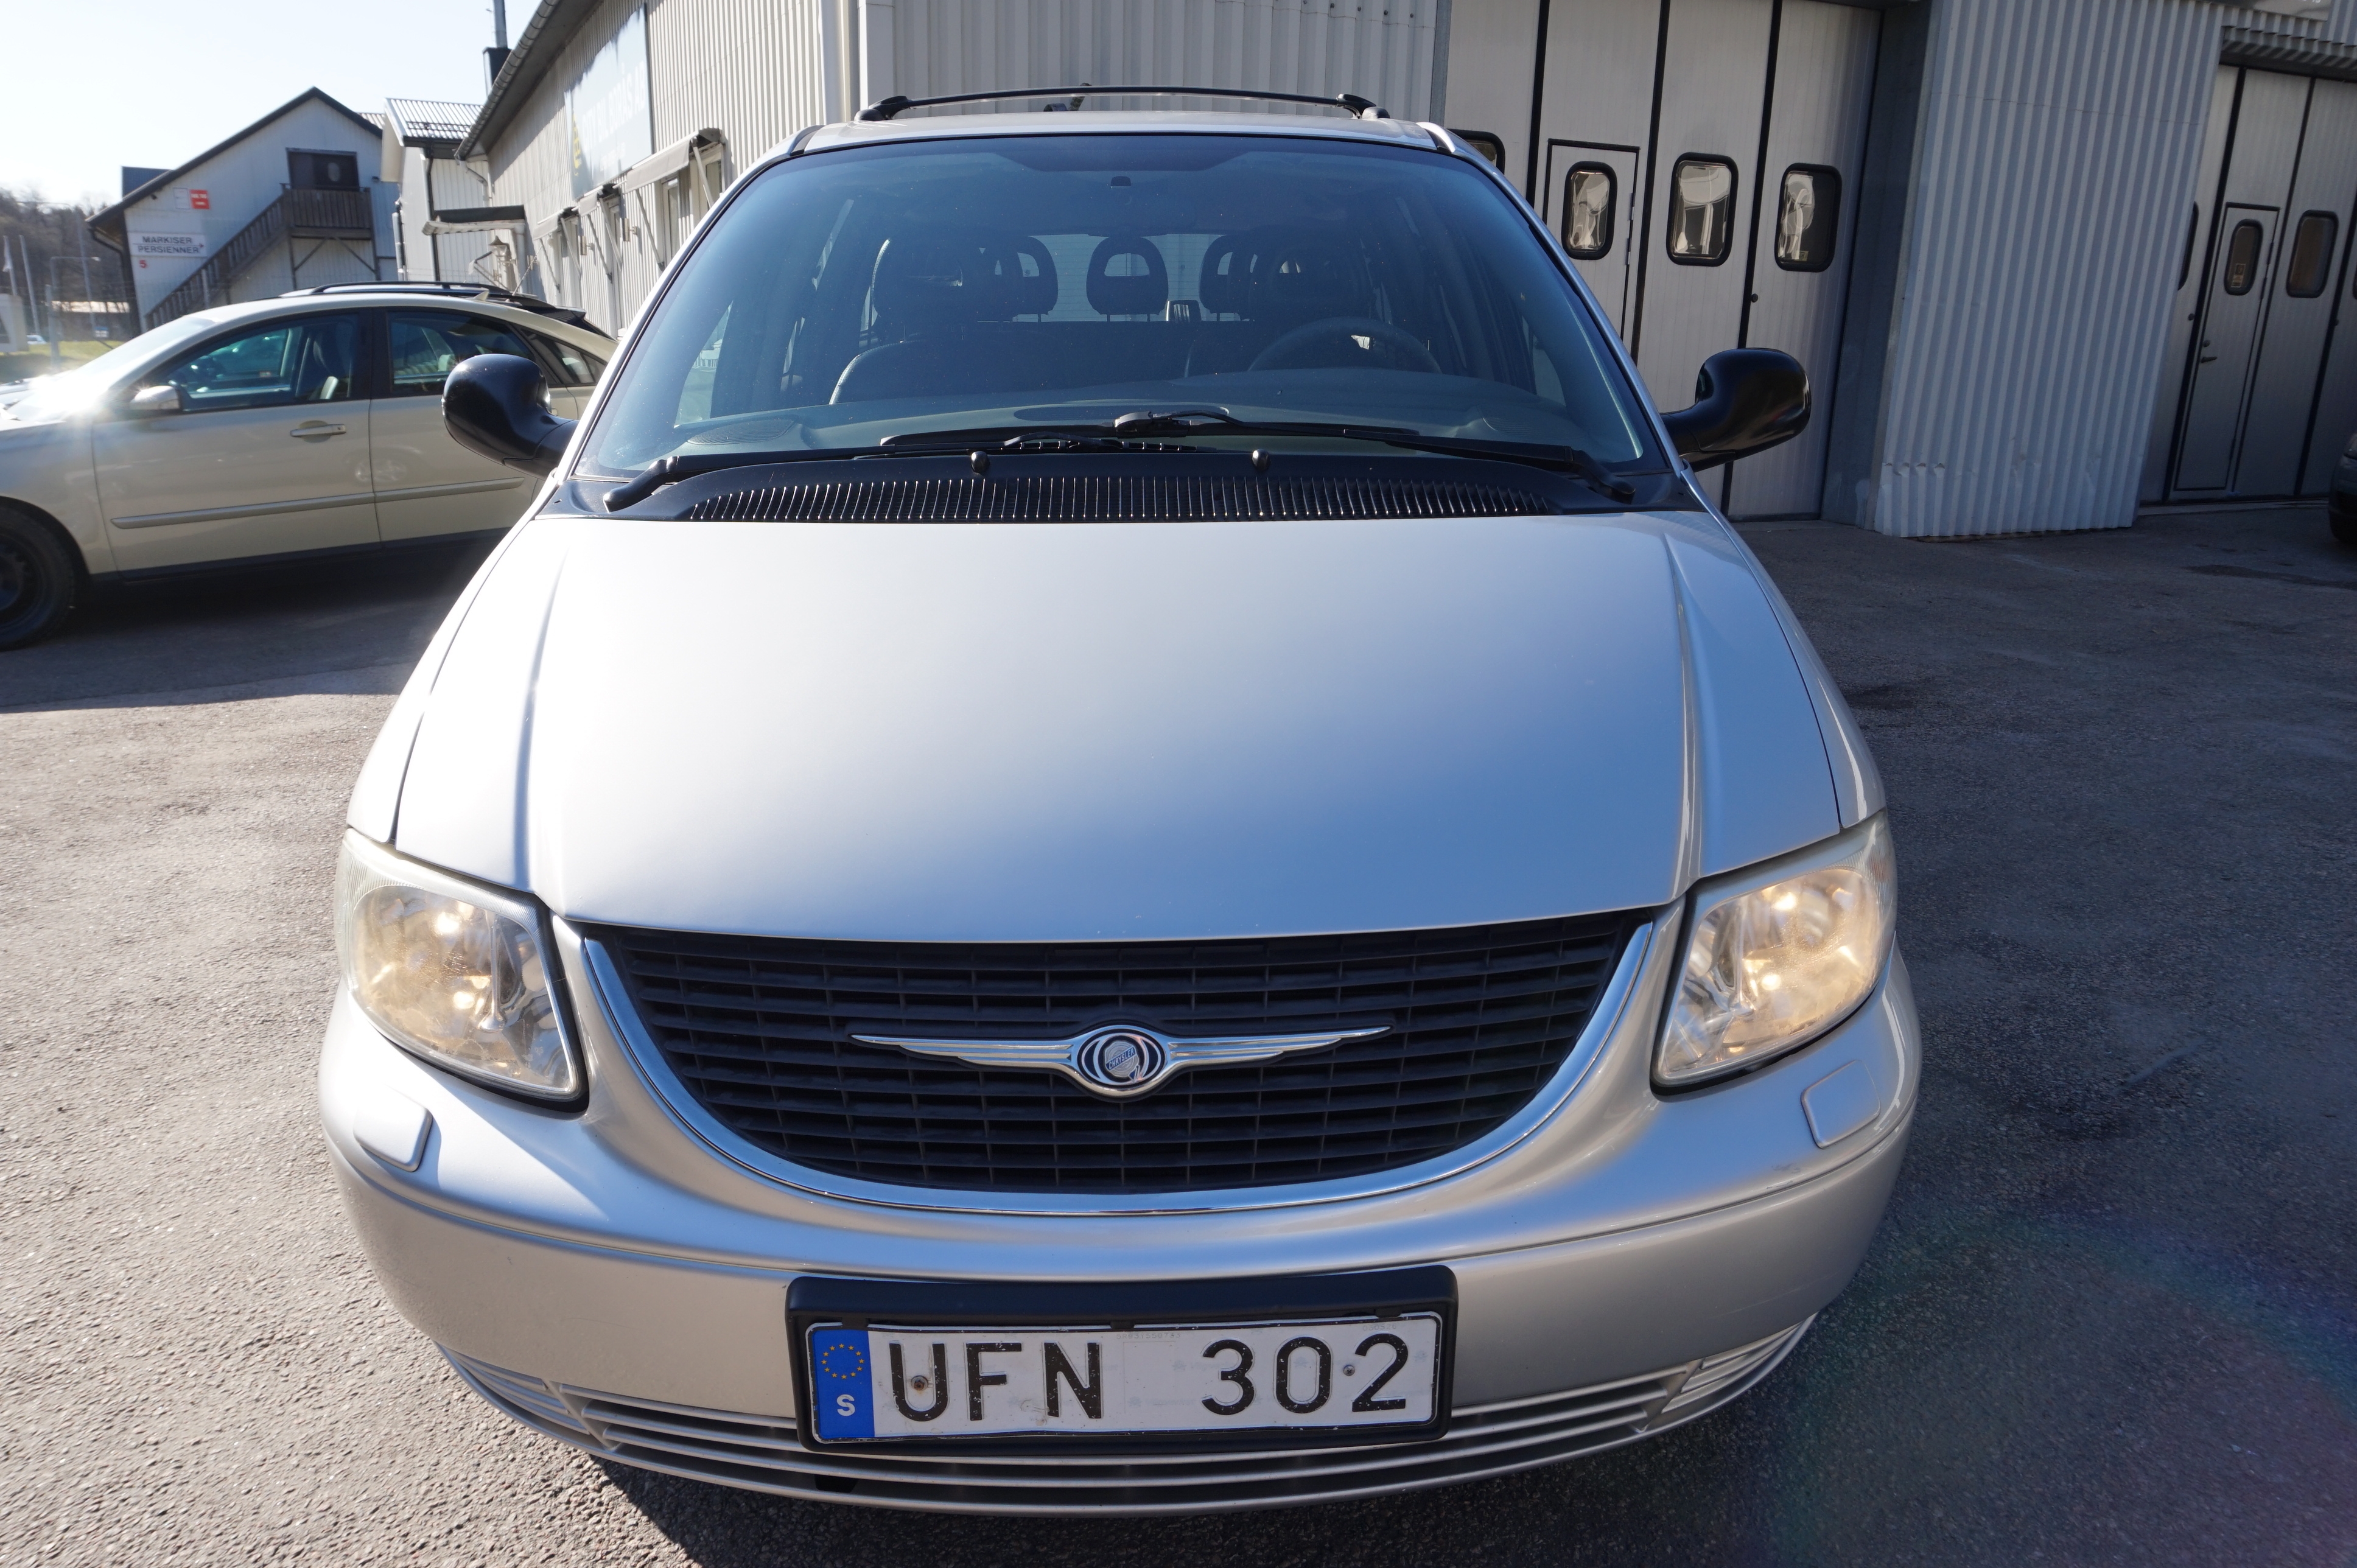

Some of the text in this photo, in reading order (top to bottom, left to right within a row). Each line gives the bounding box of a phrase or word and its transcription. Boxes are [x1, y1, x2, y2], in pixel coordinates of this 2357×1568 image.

[634, 60, 645, 115] AB
[138, 245, 199, 254] PERSIENNER
[142, 236, 192, 244] MARKISER
[139, 260, 147, 268] 5
[1108, 1049, 1135, 1070] CHRYSLER
[889, 1332, 1409, 1423] UFN 302
[836, 1393, 856, 1417] S
